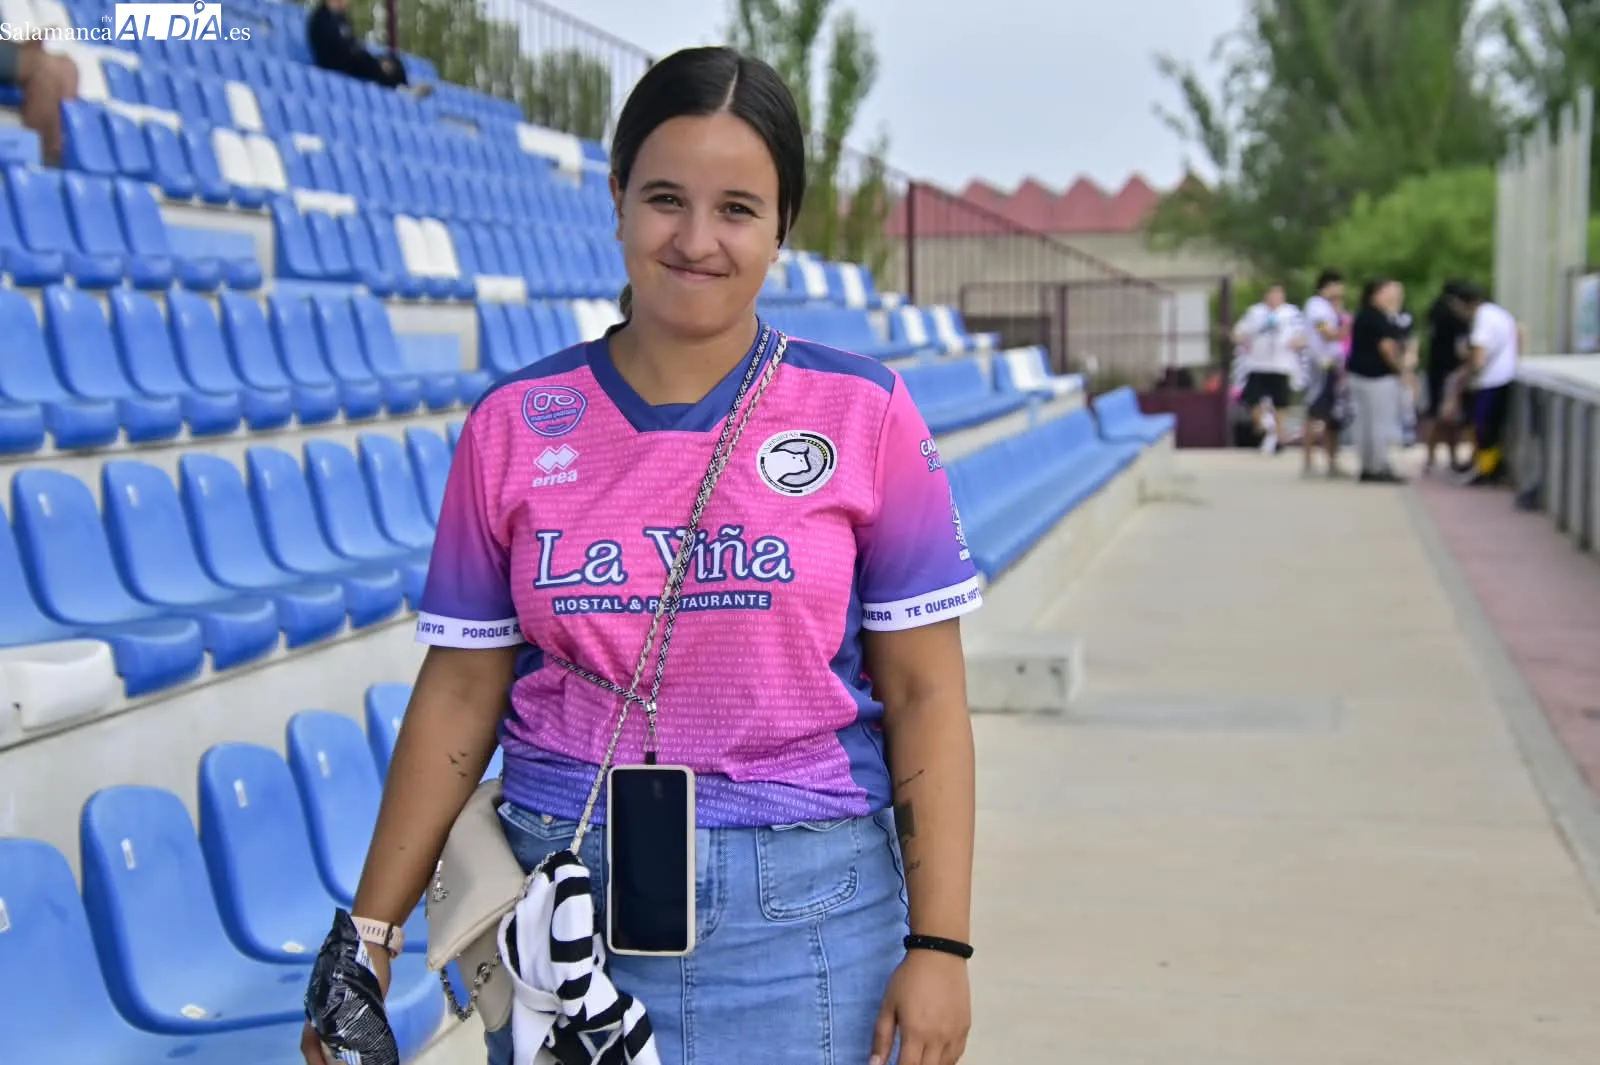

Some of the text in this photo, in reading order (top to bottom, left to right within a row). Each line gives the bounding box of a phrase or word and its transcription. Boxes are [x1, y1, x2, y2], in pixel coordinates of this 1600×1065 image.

[534, 525, 793, 588] La Viña
[555, 597, 623, 612] HOSTAL
[629, 599, 642, 611] &
[905, 605, 922, 618] TE
[925, 593, 967, 614] QUERRE
[421, 622, 445, 635] VAYA
[462, 626, 511, 638] PORQUE
